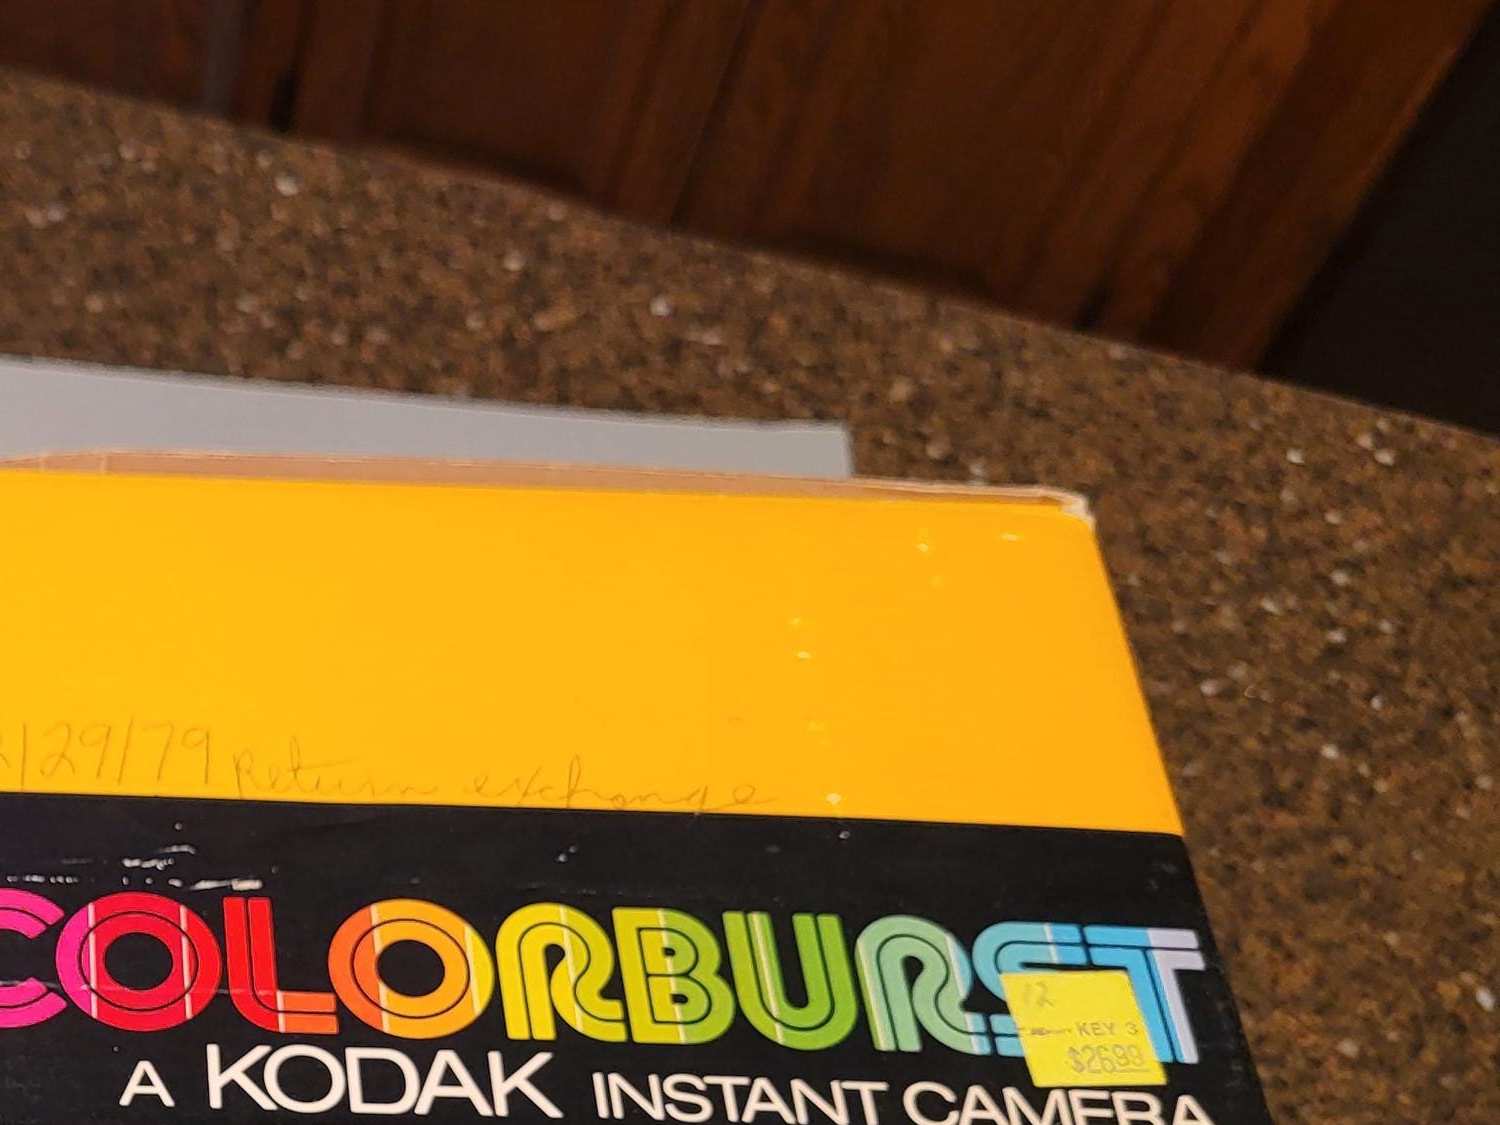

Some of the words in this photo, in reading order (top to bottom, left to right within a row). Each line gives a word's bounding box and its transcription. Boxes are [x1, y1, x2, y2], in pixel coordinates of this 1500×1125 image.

[1076, 1022, 1114, 1037] KEY
[1125, 1021, 1140, 1037] 3
[119, 1059, 175, 1107] A
[206, 1043, 564, 1119] KODAK
